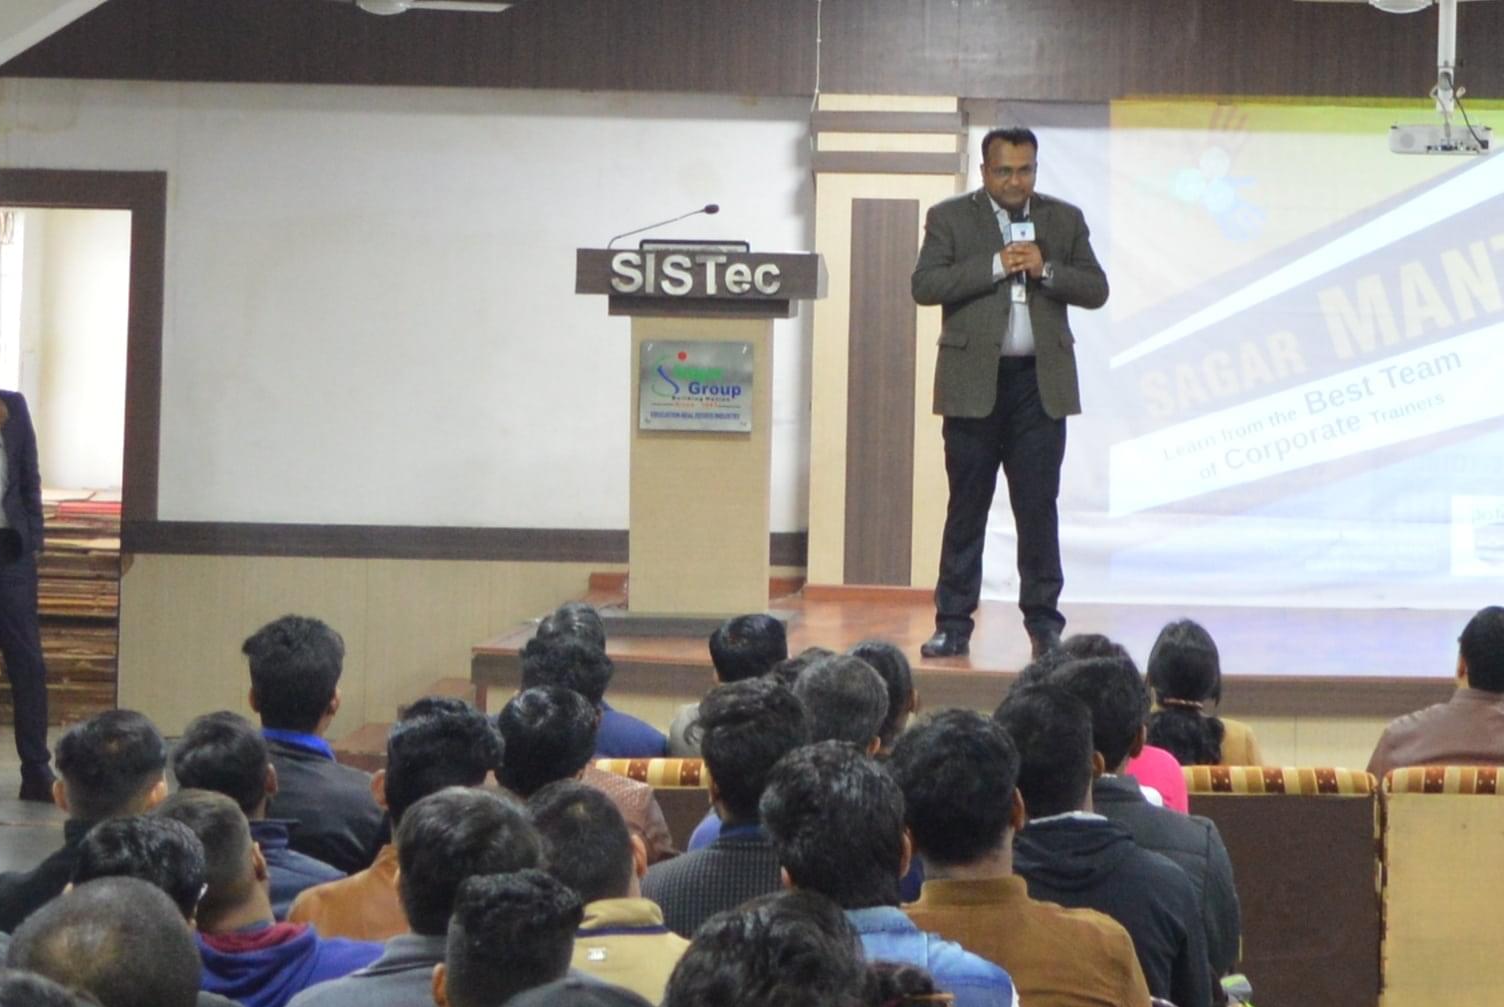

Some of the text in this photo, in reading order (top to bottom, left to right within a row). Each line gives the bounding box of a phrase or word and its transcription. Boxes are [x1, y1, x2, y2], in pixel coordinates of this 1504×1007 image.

[611, 252, 781, 295] SISTec
[688, 381, 742, 399] Group
[1138, 330, 1308, 419] SAGAR
[1269, 408, 1298, 428] the
[1304, 374, 1375, 416] Best
[1378, 350, 1463, 390] Team
[1224, 412, 1361, 471] Corporate
